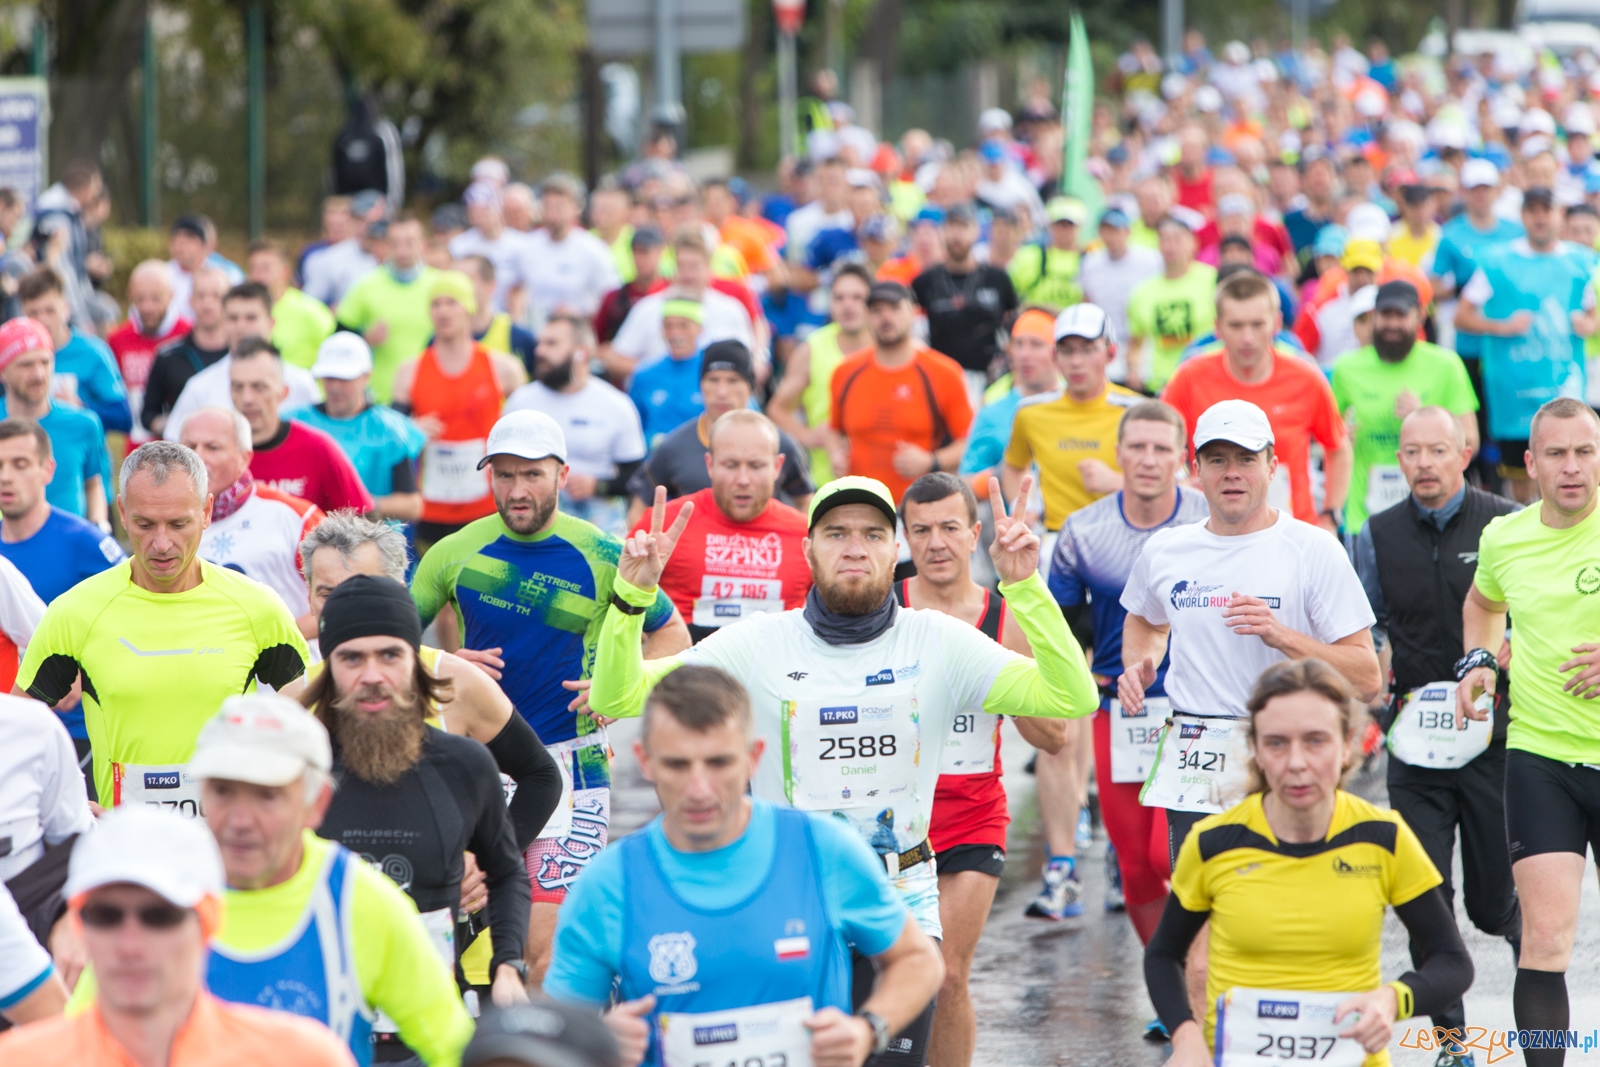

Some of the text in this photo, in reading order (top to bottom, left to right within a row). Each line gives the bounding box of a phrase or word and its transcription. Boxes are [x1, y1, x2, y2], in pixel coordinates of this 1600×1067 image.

[705, 546, 782, 568] SZPIKU
[532, 571, 582, 593] EXTREME
[478, 593, 531, 616] HOBBY TM
[1178, 596, 1209, 608] WORLD
[822, 710, 856, 721] 17.PKO
[819, 734, 897, 760] 2588
[841, 764, 877, 776] Daniel
[1178, 750, 1226, 772] 3421
[146, 776, 178, 785] 17.PKO
[1180, 775, 1213, 785] Bartosz
[1256, 1033, 1337, 1060] 2937
